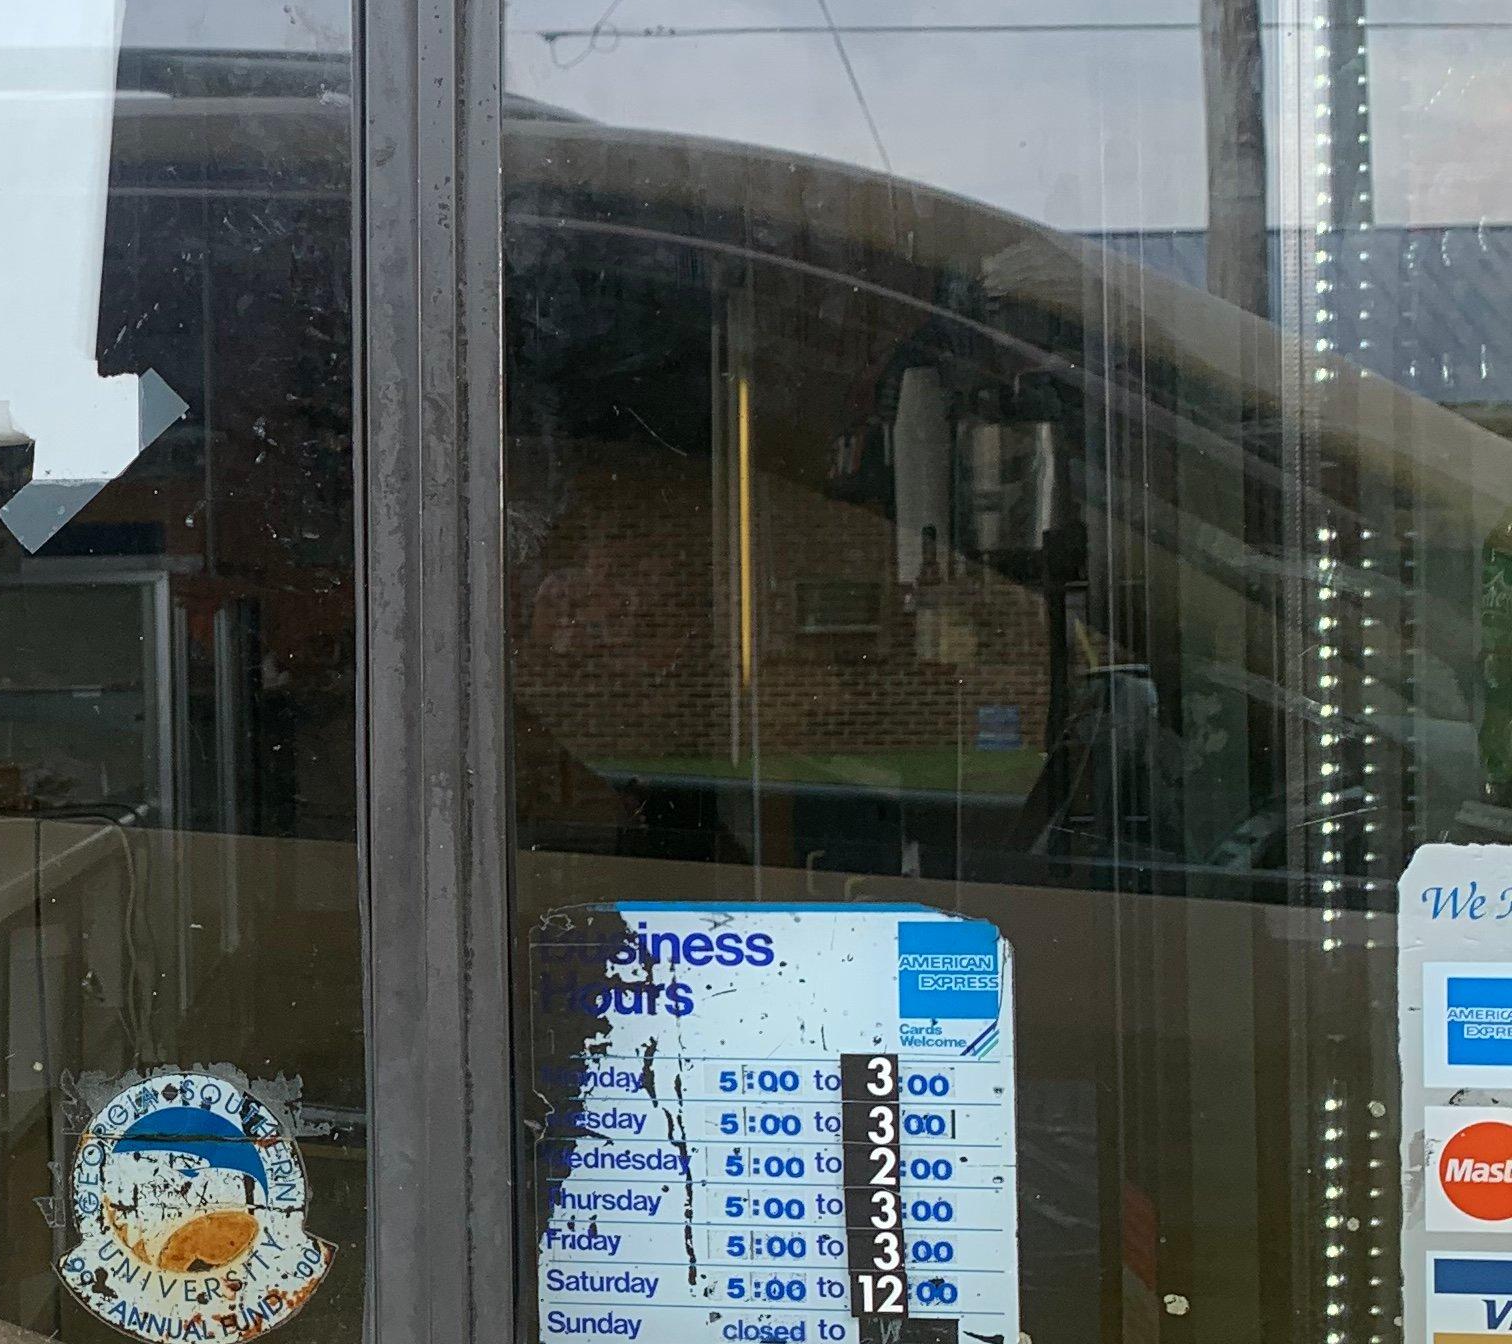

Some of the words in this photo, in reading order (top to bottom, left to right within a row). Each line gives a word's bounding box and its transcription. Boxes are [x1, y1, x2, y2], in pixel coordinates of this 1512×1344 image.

[1421, 881, 1487, 920] We
[540, 921, 775, 967] siness
[899, 954, 994, 972] AMERICAN
[541, 976, 694, 1017] ours
[918, 973, 1000, 991] EXPRESS
[899, 1023, 943, 1036] Cards
[899, 1035, 968, 1048] Welcome
[542, 1067, 646, 1093] nday
[719, 1070, 800, 1093] 5:00
[814, 1069, 841, 1092] to
[547, 1108, 647, 1135] esday
[720, 1112, 802, 1136] 5:00
[814, 1111, 841, 1133] to
[77, 1085, 160, 1214] GEORGIA
[181, 1079, 297, 1203] SOUTHERN
[541, 1147, 692, 1176] ednesday
[725, 1155, 805, 1178] 5:00
[815, 1152, 842, 1174] to
[547, 1186, 662, 1216] Thursday
[725, 1197, 805, 1220] 5:00
[815, 1194, 843, 1216] to
[546, 1228, 621, 1256] Friday
[727, 1235, 806, 1258] 5:00
[817, 1235, 844, 1257] to
[98, 1233, 286, 1303] UNIVERSITY
[547, 1269, 659, 1298] Saturday
[727, 1278, 806, 1301] 5:00
[817, 1277, 845, 1298] to
[108, 1299, 216, 1341] ANNUAL
[221, 1292, 285, 1334] FUND
[547, 1311, 642, 1339] Sunday
[723, 1319, 805, 1342] closed
[818, 1319, 846, 1341] to
[1482, 1299, 1512, 1330] V
